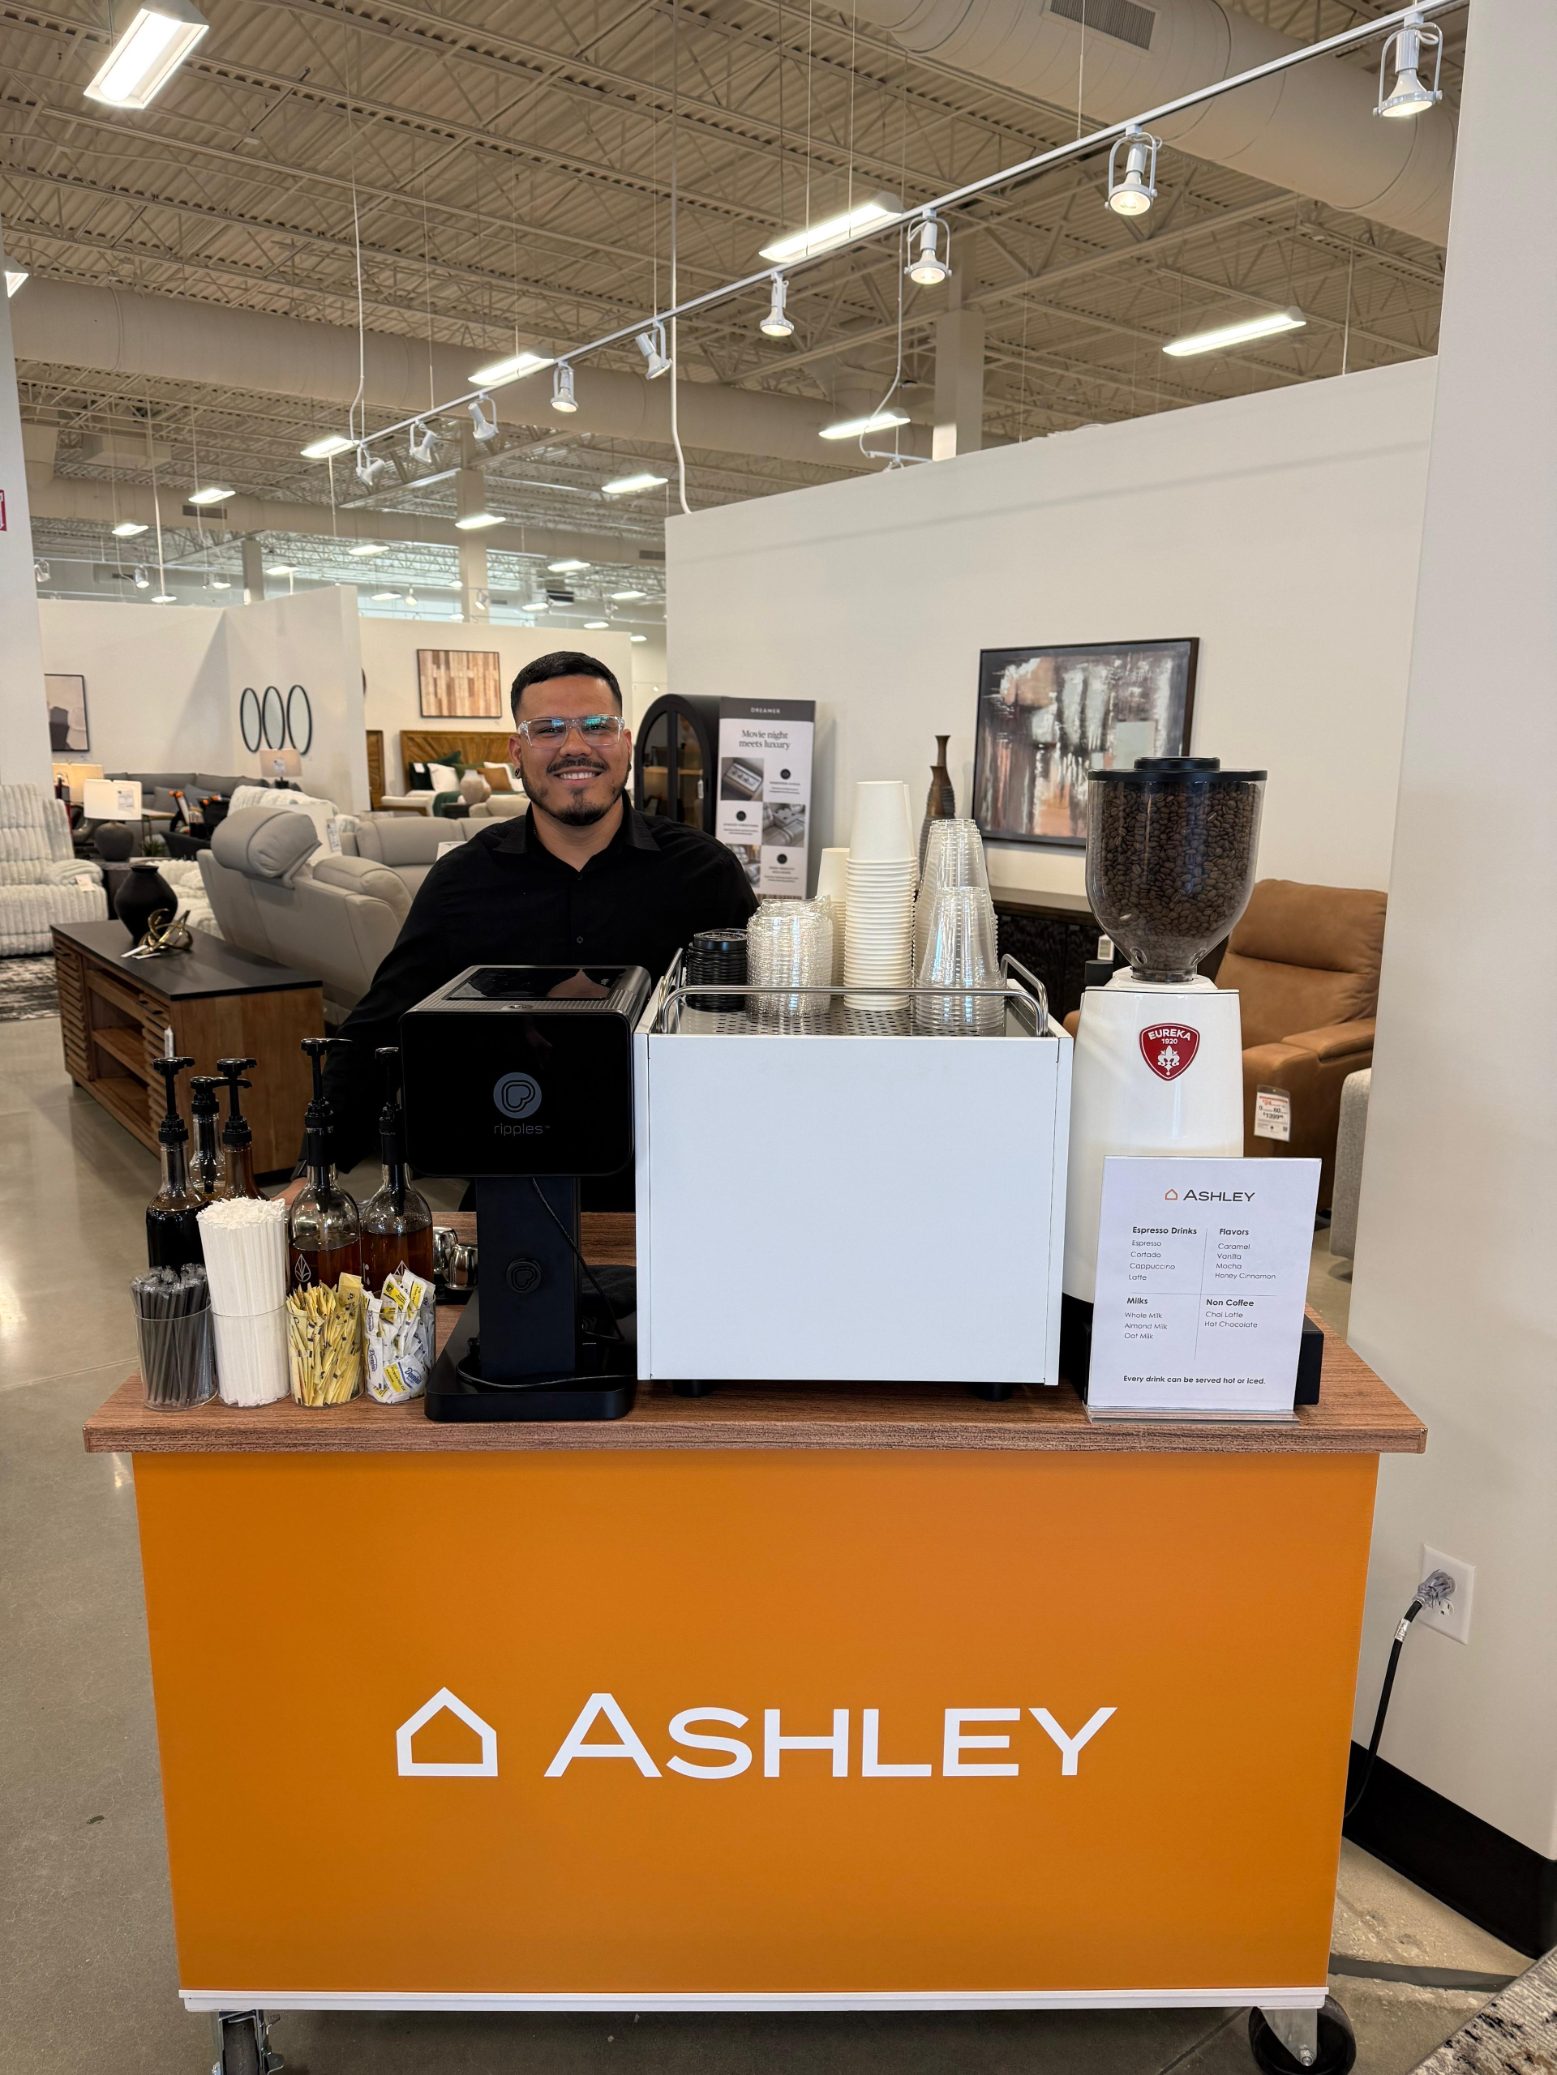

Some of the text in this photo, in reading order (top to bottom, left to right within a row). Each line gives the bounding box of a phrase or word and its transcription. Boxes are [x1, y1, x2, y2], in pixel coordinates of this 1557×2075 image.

[742, 730, 788, 740] Movie night
[739, 740, 790, 750] meets luxury
[1148, 1028, 1191, 1041] EUREKA
[494, 1123, 543, 1136] ripples
[1183, 1189, 1256, 1202] ASHLEY
[1133, 1226, 1168, 1234] Espresso
[544, 1692, 1118, 1779] ASHLEY
